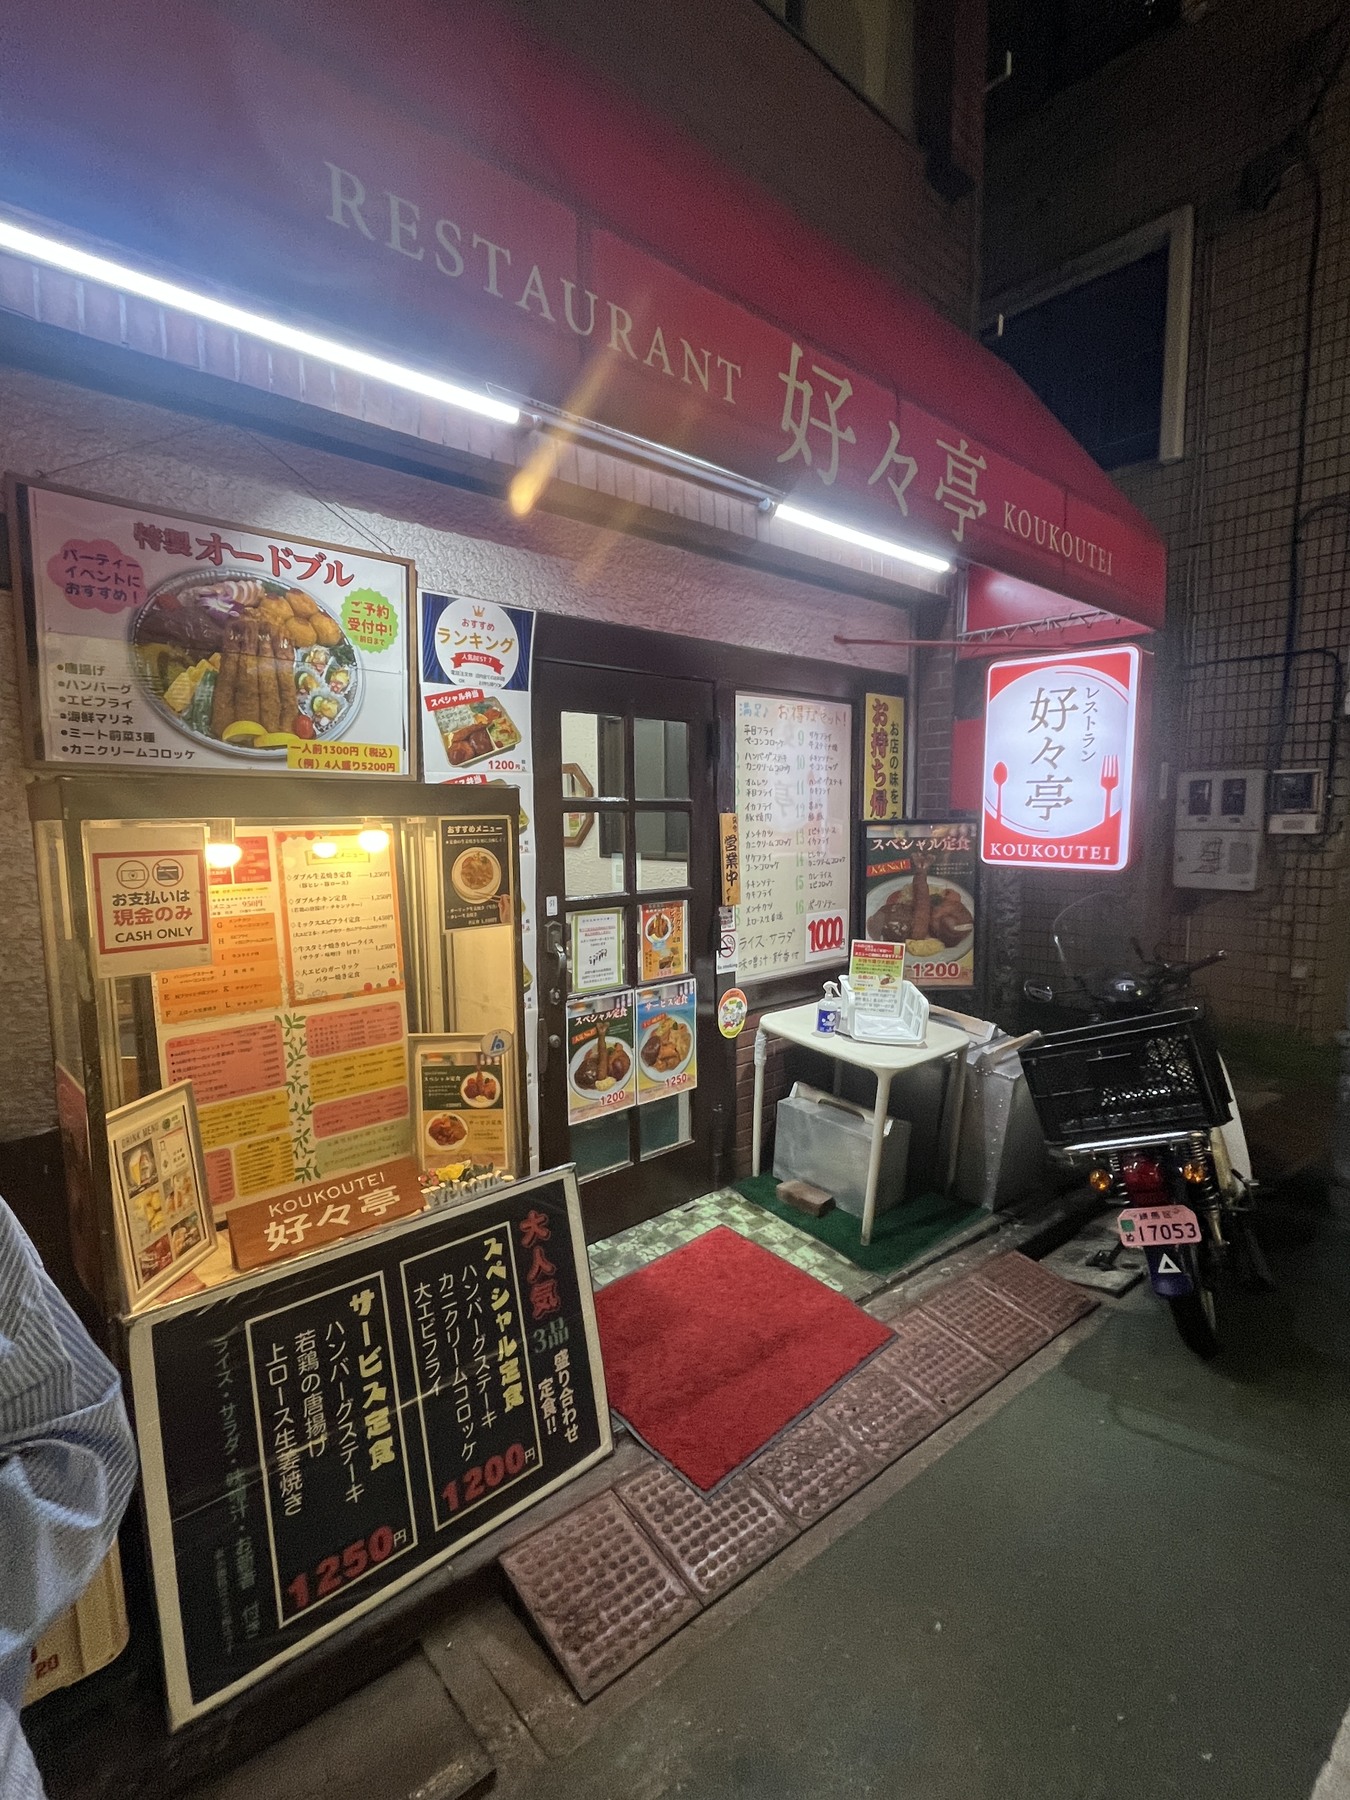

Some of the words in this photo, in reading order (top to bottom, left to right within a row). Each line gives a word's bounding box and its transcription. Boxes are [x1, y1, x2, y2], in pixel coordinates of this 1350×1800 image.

[324, 161, 742, 404] RESTAURANT
[777, 342, 987, 541] 好々亭
[1003, 500, 1114, 576] KOUKOUTEI
[133, 522, 355, 587] 特製オードブル
[65, 566, 141, 588] イベントに
[351, 601, 390, 620] ご予約
[461, 617, 496, 632] おすすめ
[437, 627, 515, 654] ランキング
[66, 679, 132, 695] ハンバーグ
[67, 695, 133, 710] エビフライ
[430, 691, 480, 708] スペシャル弁当
[67, 711, 134, 725] 海鮮マリネ
[1081, 686, 1100, 763] レストラン
[69, 728, 156, 743] ミート前菜3種
[797, 729, 805, 746] 9
[70, 744, 196, 760] カニクリームコロッケ
[870, 697, 889, 820] お持ち帰
[1025, 686, 1079, 822] 好々亭
[488, 760, 521, 771] 1200円
[796, 754, 806, 770] 10
[745, 802, 773, 811] イカフライ
[447, 825, 503, 834] おすすめメニュー
[745, 830, 774, 838] メンチカツ
[870, 837, 970, 851] スペシャル定食
[990, 842, 1112, 861] KOUKOUTEI
[724, 835, 738, 887] 営業中
[293, 872, 352, 881] ダブル生姜焼き定食
[795, 875, 804, 891] 15
[112, 889, 190, 907] お支払いは
[294, 894, 348, 905] ダブルチキン定食
[795, 899, 804, 915] 16
[113, 906, 193, 926] 現金のみ
[746, 902, 773, 914] メンチカツ
[296, 916, 361, 928] ミックスエビフライ定食
[114, 931, 152, 943] CASH
[157, 926, 193, 939] ONLY
[298, 938, 375, 953] 牛スタミナ焼きカレーライス
[301, 963, 360, 977] 大エビのガーリック
[315, 971, 361, 983] バター焼き定食
[223, 985, 229, 993] K
[645, 994, 688, 1011] サービス定食
[574, 1007, 628, 1027] スペシャル定食
[269, 1171, 386, 1218] KOUKOUTEI
[263, 1185, 401, 1252] 好々亭
[1139, 1210, 1172, 1220] 練馬区
[1138, 1222, 1197, 1242] 17053
[519, 1209, 561, 1321] 大人気
[484, 1237, 524, 1414] スペシャル定食
[532, 1316, 569, 1354] 3品
[413, 1282, 442, 1396] 大エビフライ
[461, 1264, 497, 1429] ハンバーグステーキ
[438, 1273, 477, 1462] カニクリームコロッケ
[349, 1288, 395, 1472] サービス定食
[294, 1329, 328, 1459] 若鶏の唐揚げ
[553, 1348, 579, 1444] 盛り合わせ
[325, 1320, 365, 1504] ハンバーグステーキ
[265, 1343, 303, 1517] 上ロース生姜焼き
[442, 1442, 536, 1512] 1200円
[287, 1525, 408, 1610] 1250円
